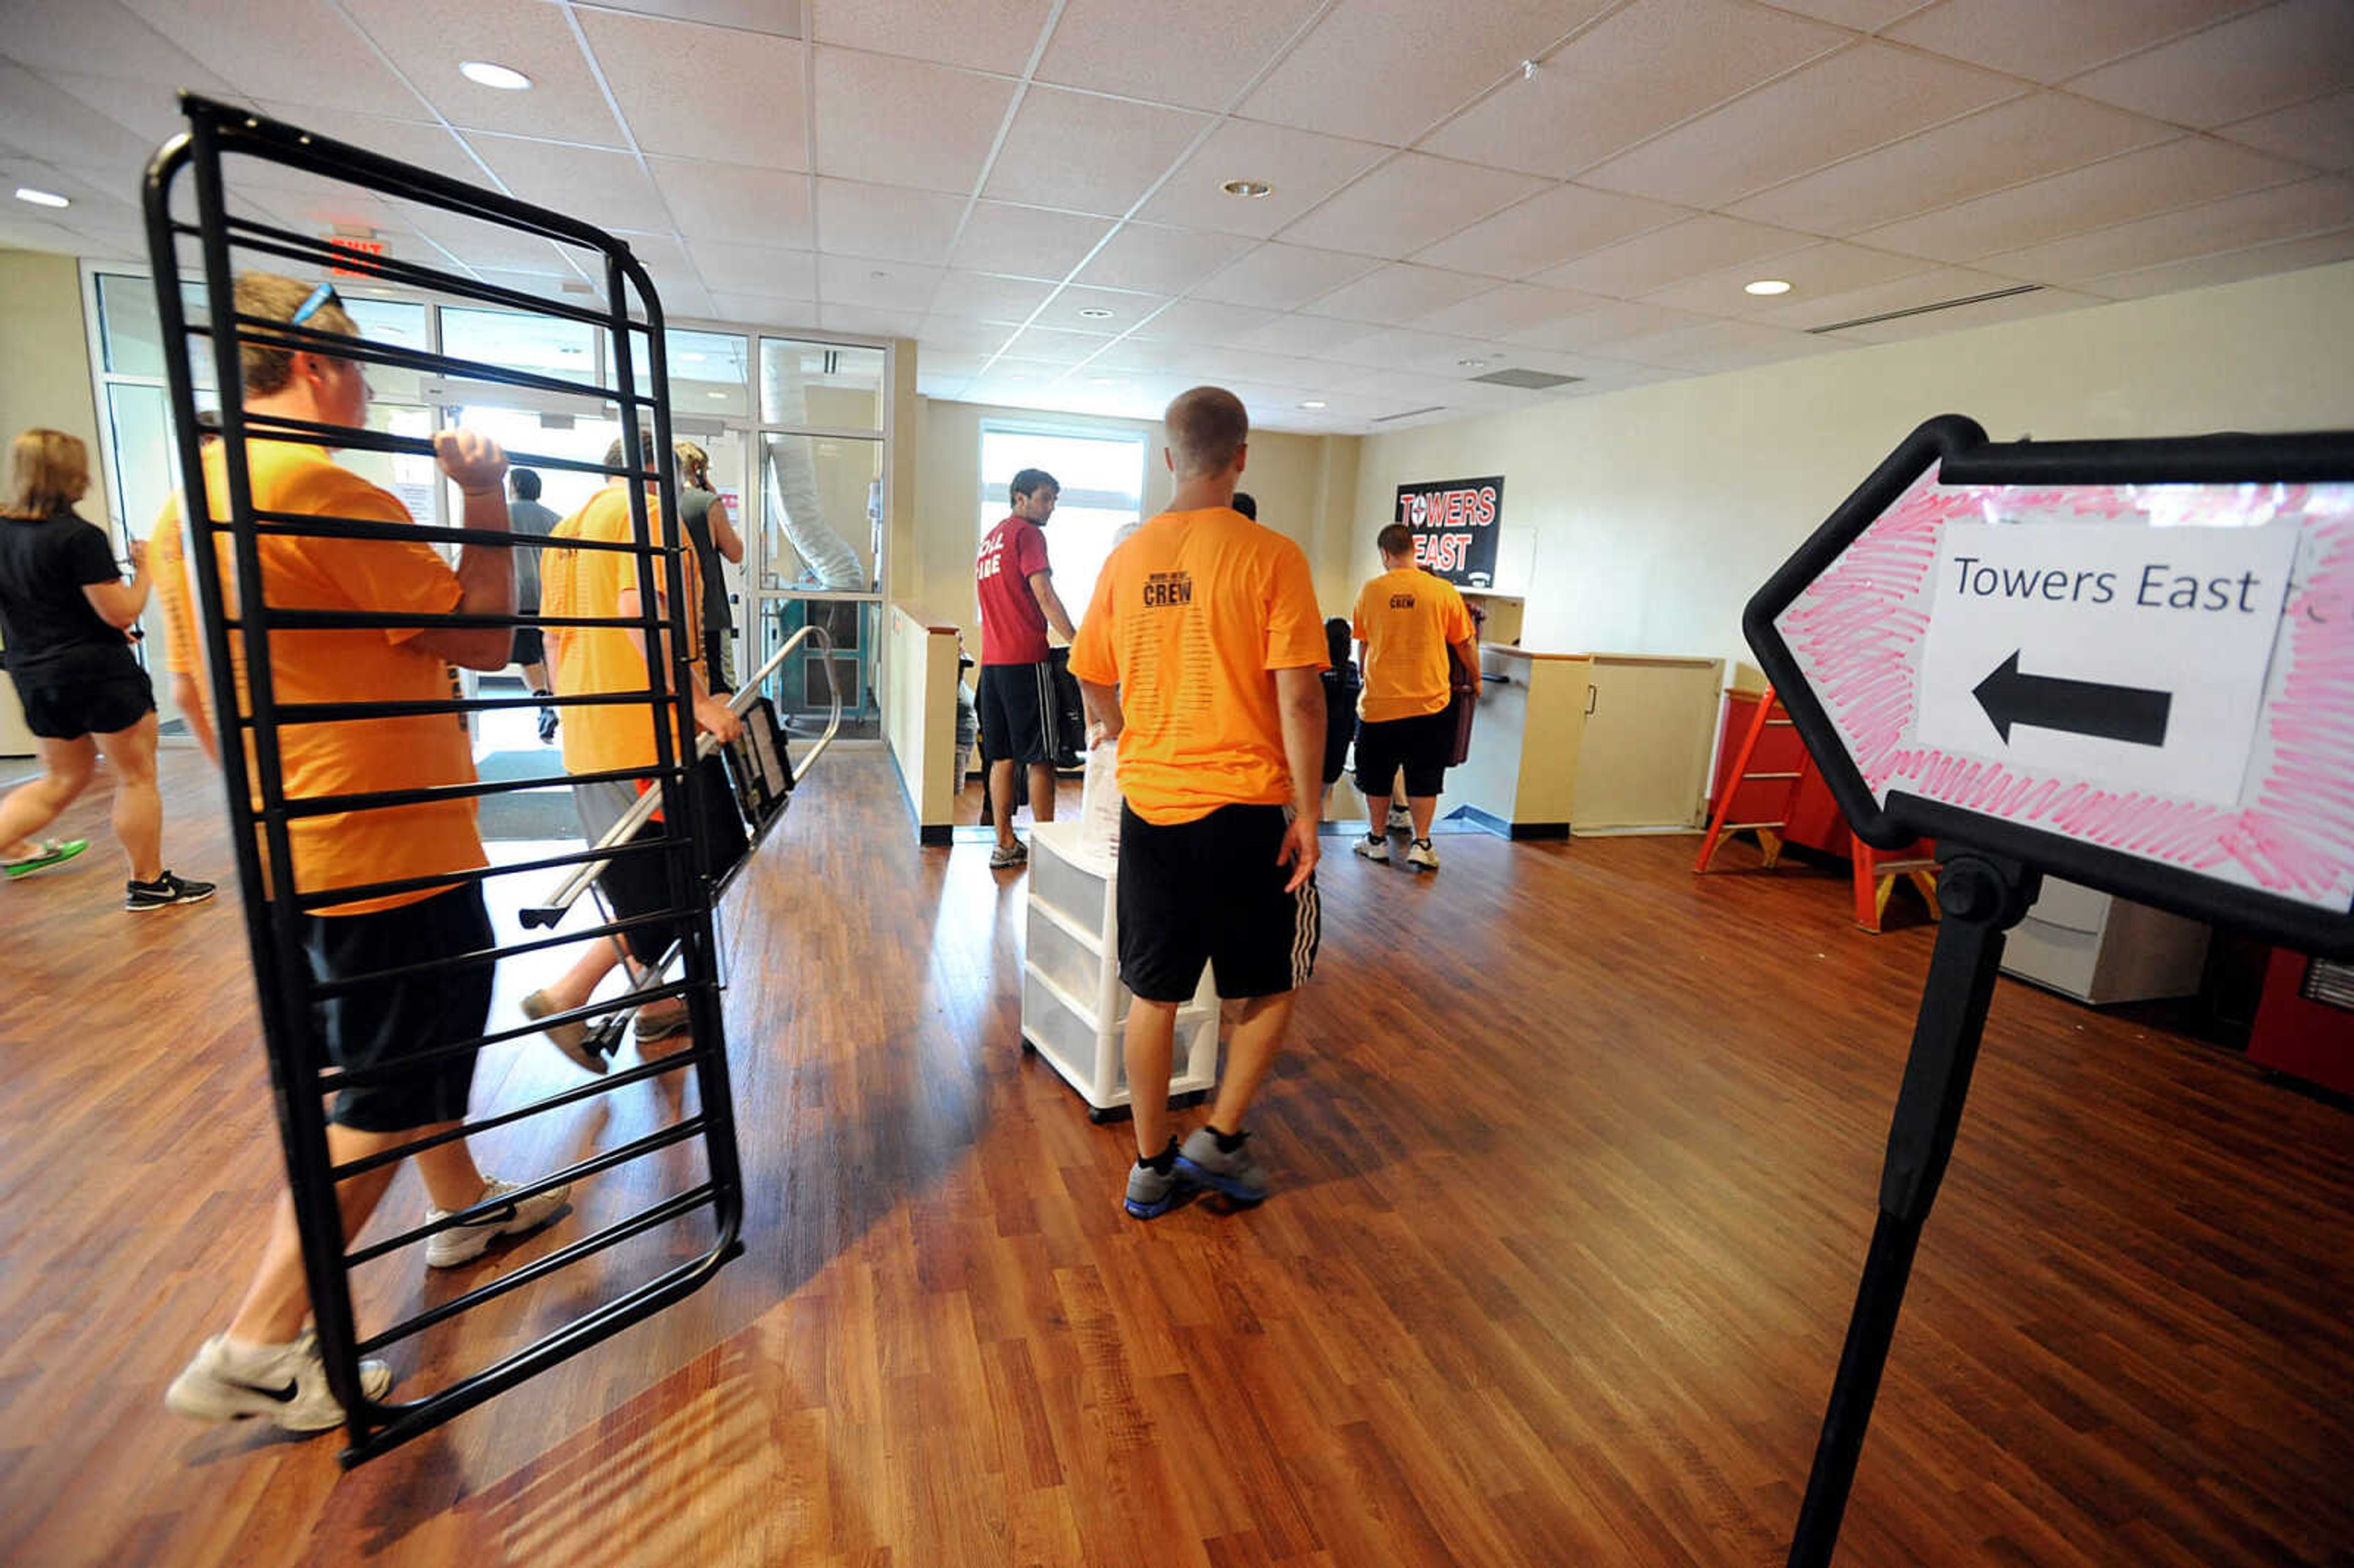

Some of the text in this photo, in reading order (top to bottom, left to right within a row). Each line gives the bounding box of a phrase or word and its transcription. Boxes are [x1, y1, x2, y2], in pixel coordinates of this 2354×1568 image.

[1400, 485, 1496, 530] TOWERS
[1412, 532, 1472, 571] EAST
[1144, 580, 1192, 606] CREW
[1953, 557, 2260, 614] Towers East
